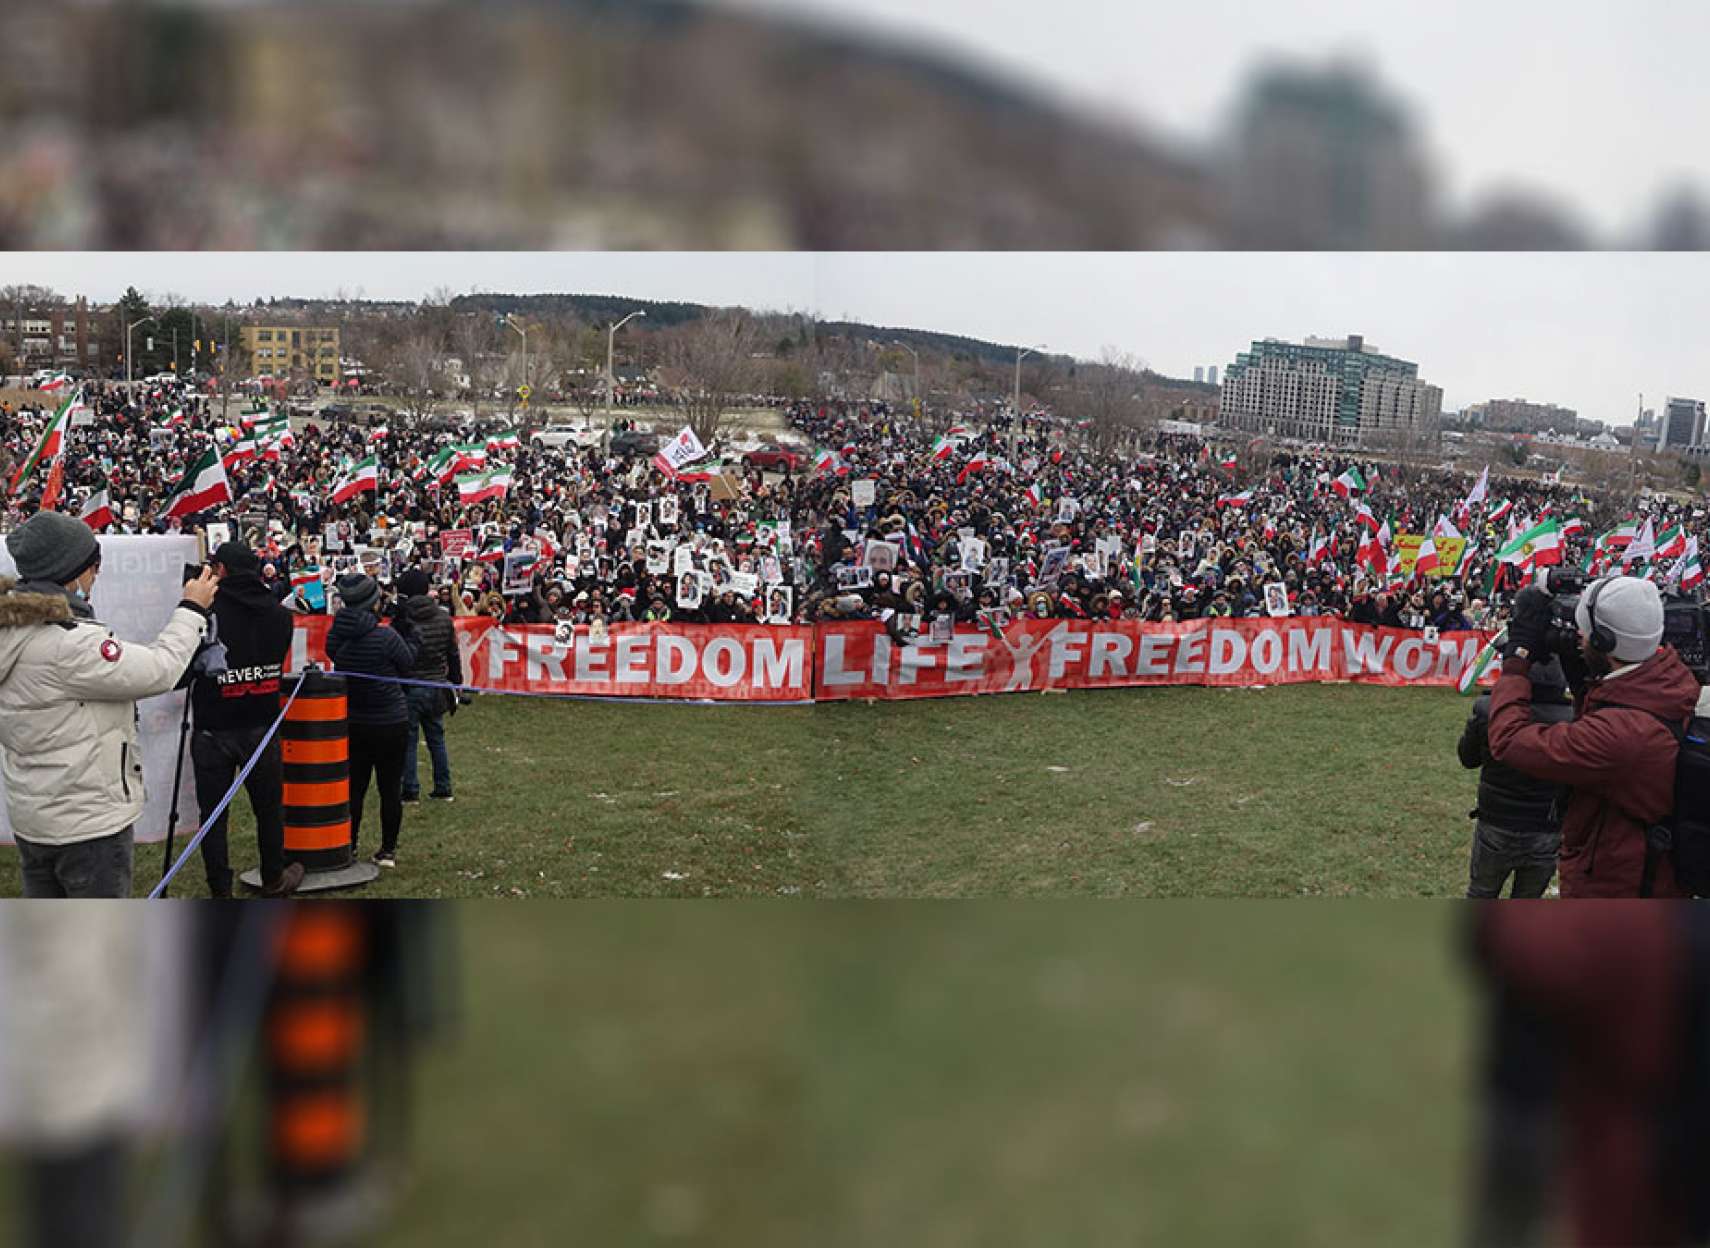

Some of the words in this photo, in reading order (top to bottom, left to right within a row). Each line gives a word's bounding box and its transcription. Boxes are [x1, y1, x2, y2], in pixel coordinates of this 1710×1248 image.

[217, 666, 263, 685] NEVER
[489, 632, 806, 688] FREEDOM
[823, 633, 988, 685] LIFE
[1048, 628, 1332, 678] FREEDOM
